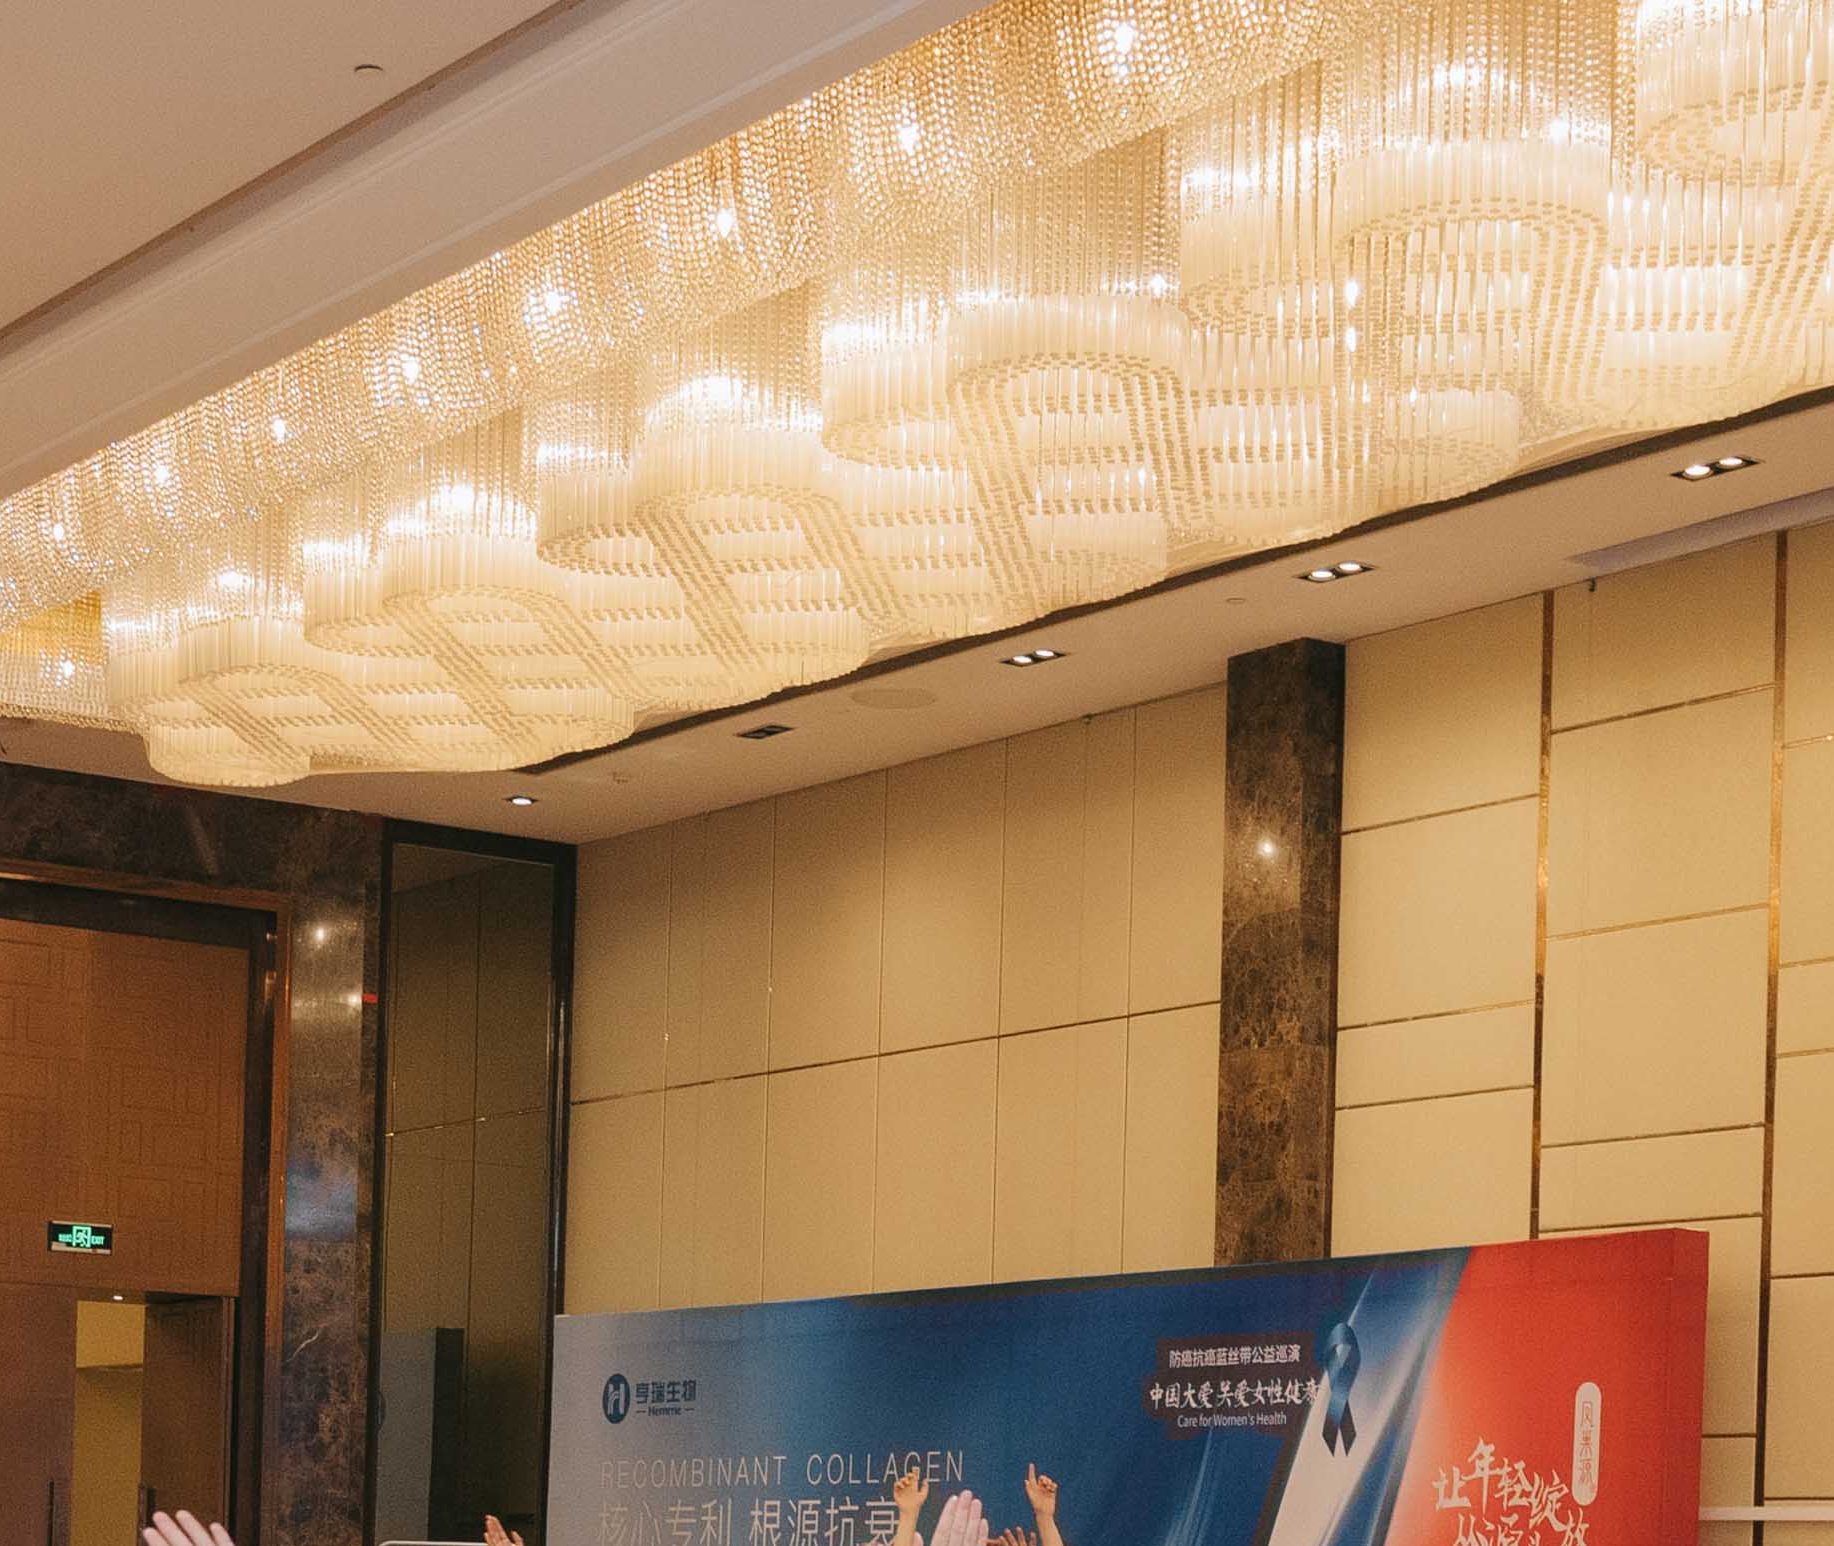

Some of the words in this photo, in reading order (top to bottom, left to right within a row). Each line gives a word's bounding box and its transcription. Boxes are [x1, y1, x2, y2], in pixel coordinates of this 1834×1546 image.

[1177, 1414, 1199, 1428] Care
[1199, 1413, 1214, 1426] for
[1213, 1413, 1255, 1427] Women's
[1256, 1411, 1287, 1425] Health
[601, 1455, 787, 1488] RECOMBINANT
[806, 1450, 963, 1485] COLLAGEN
